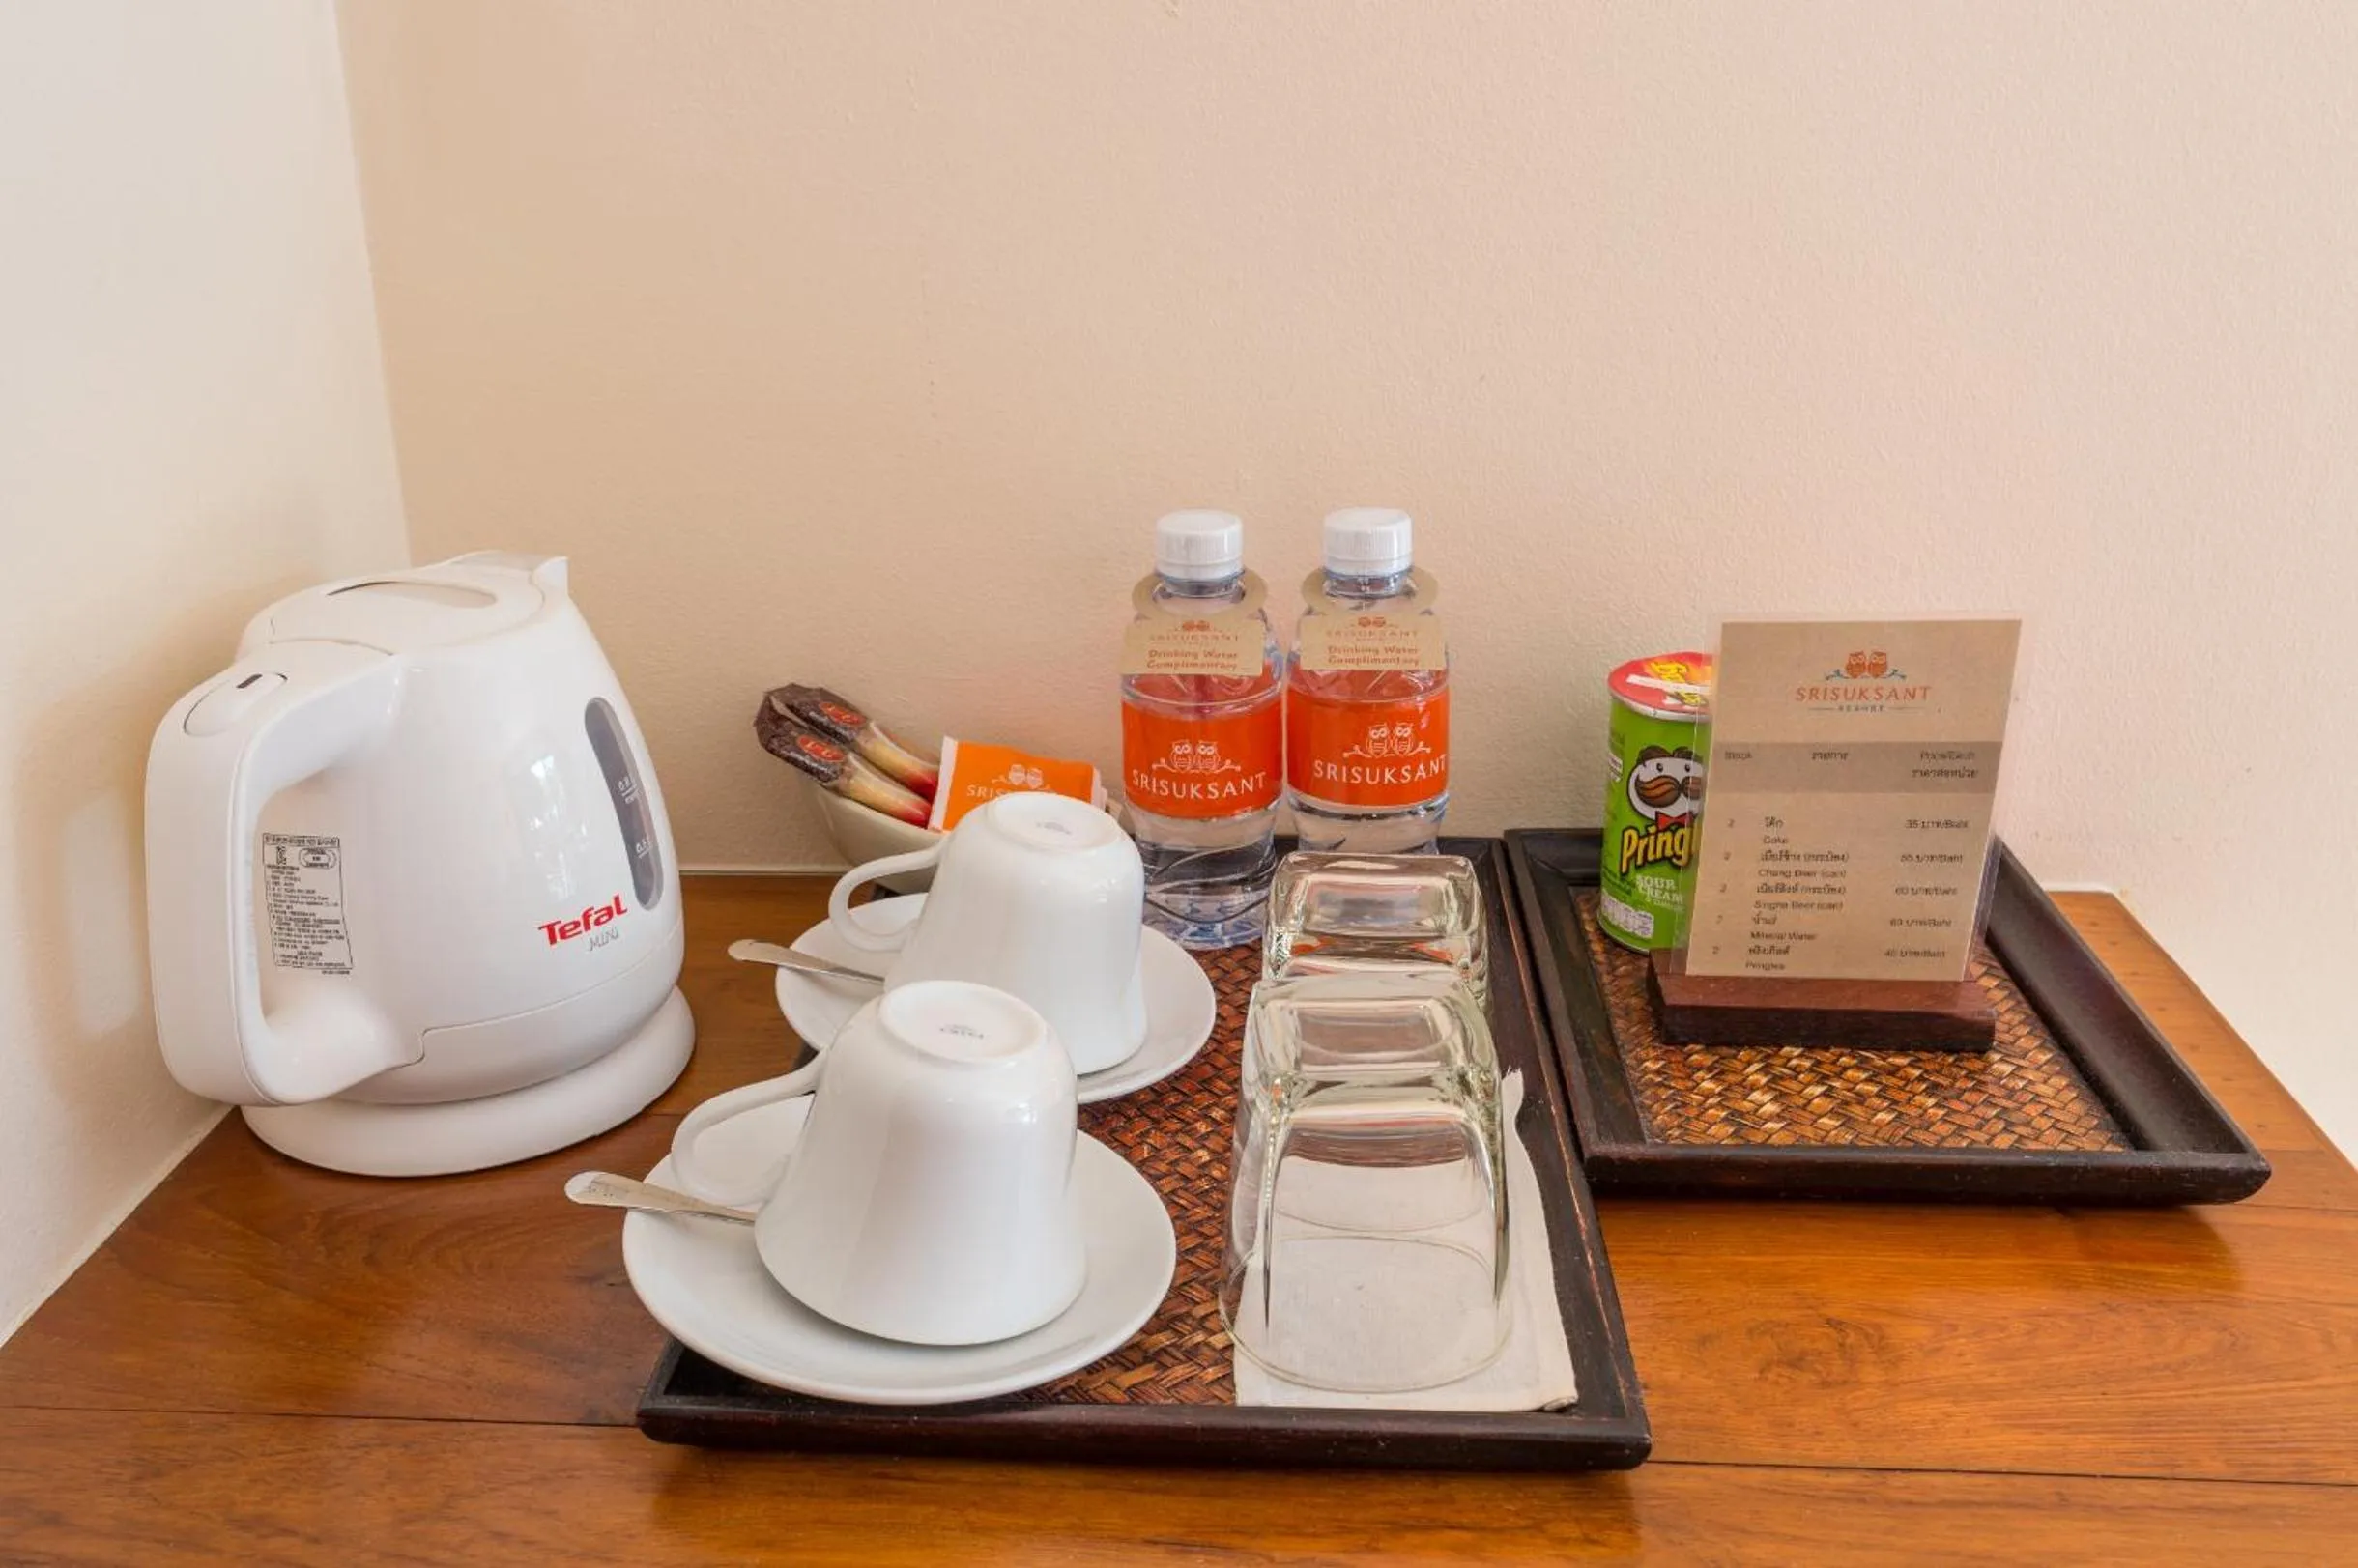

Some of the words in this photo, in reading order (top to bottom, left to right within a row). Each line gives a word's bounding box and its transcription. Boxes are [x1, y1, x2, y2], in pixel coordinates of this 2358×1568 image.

[1148, 649, 1198, 660] Drinking
[1203, 649, 1238, 659] Water
[1328, 645, 1380, 655] Drinking
[1384, 645, 1419, 654] Water
[1146, 659, 1238, 671] Complimentary
[1328, 655, 1420, 667] Complimentary
[1795, 685, 1932, 702] SRISUKSANT
[1312, 754, 1448, 786] SRISUKSANT
[1132, 769, 1268, 801] SRISUKSANT
[1621, 824, 1701, 874] Pringl
[1635, 874, 1676, 891] SOUR
[538, 894, 628, 947] Tefal
